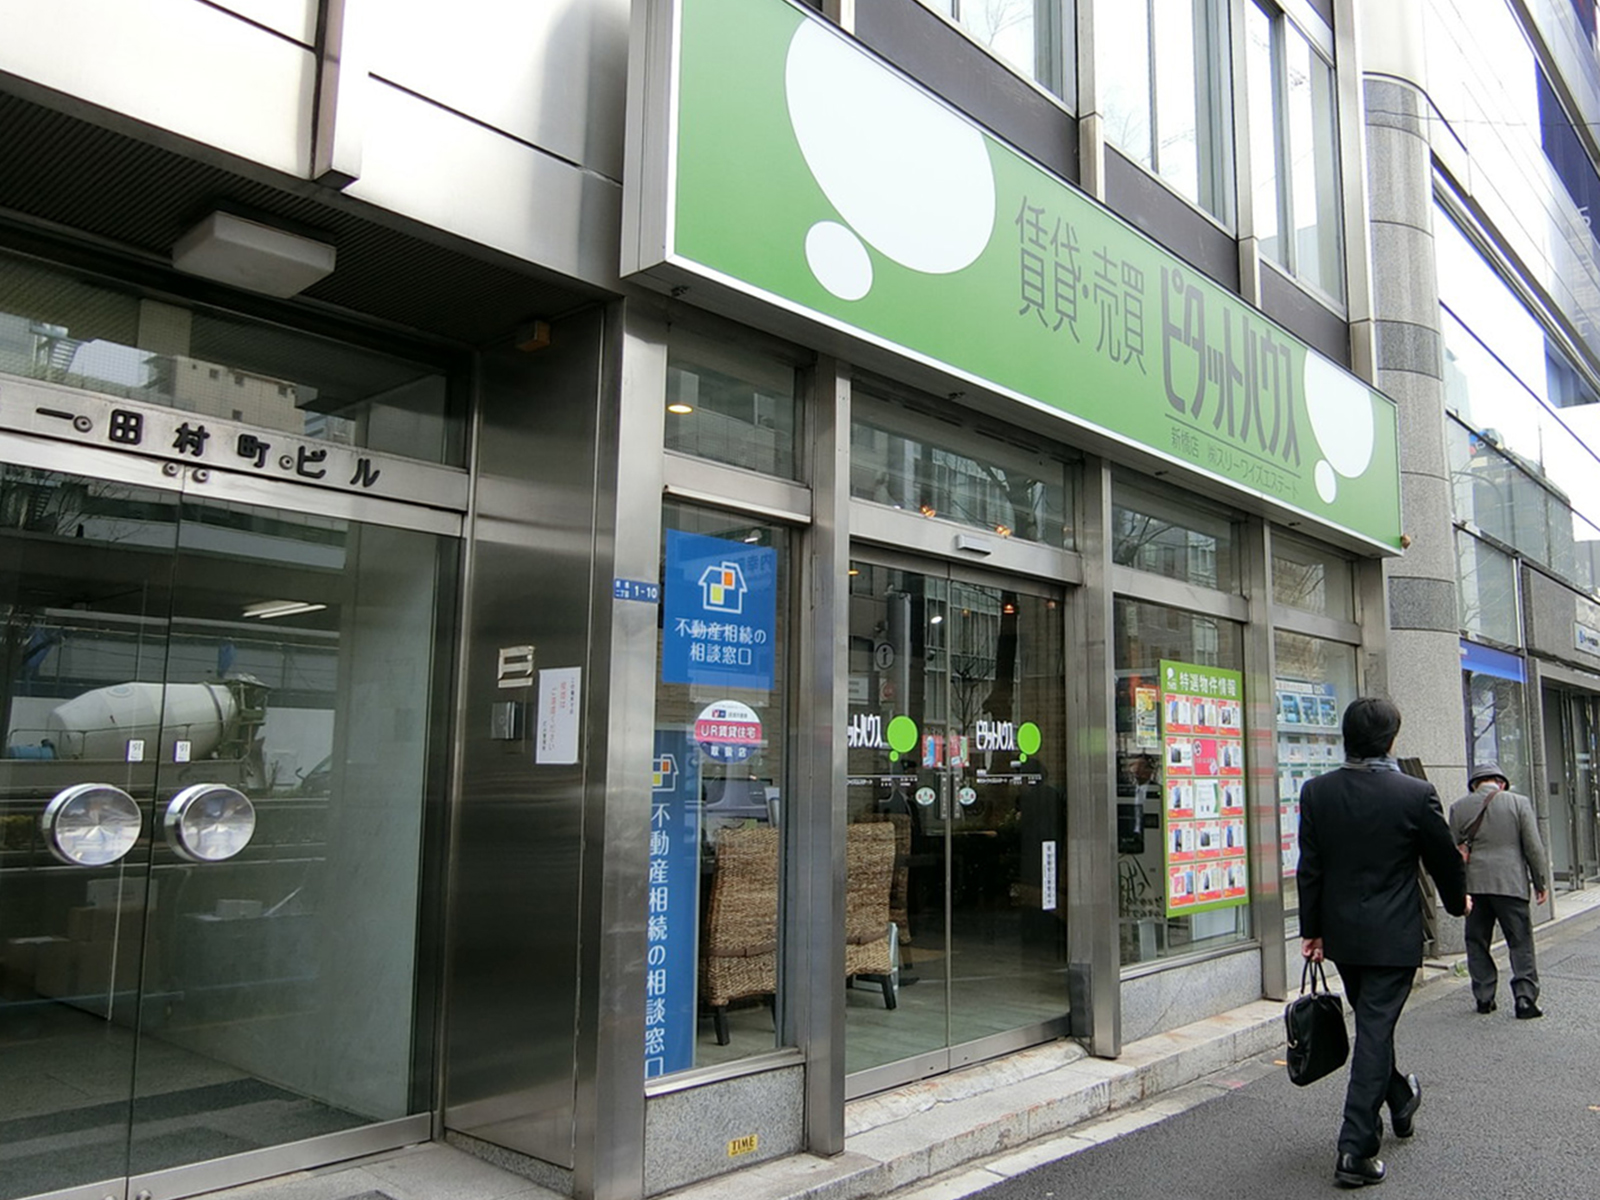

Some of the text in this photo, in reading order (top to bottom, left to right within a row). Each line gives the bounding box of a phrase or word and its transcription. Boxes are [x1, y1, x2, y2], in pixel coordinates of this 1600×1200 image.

[1015, 196, 1300, 468] 賃貸・売買 ピタットハウス
[635, 585, 658, 599] 1-10
[675, 617, 766, 645] 不動産相続の
[690, 643, 752, 665] 相談窓口
[1179, 671, 1236, 696] 特選物件情報
[700, 724, 756, 739] UR賃貸住宅
[644, 803, 671, 1079] 不動産相続の相談窓口
[731, 1135, 754, 1149] TIME
